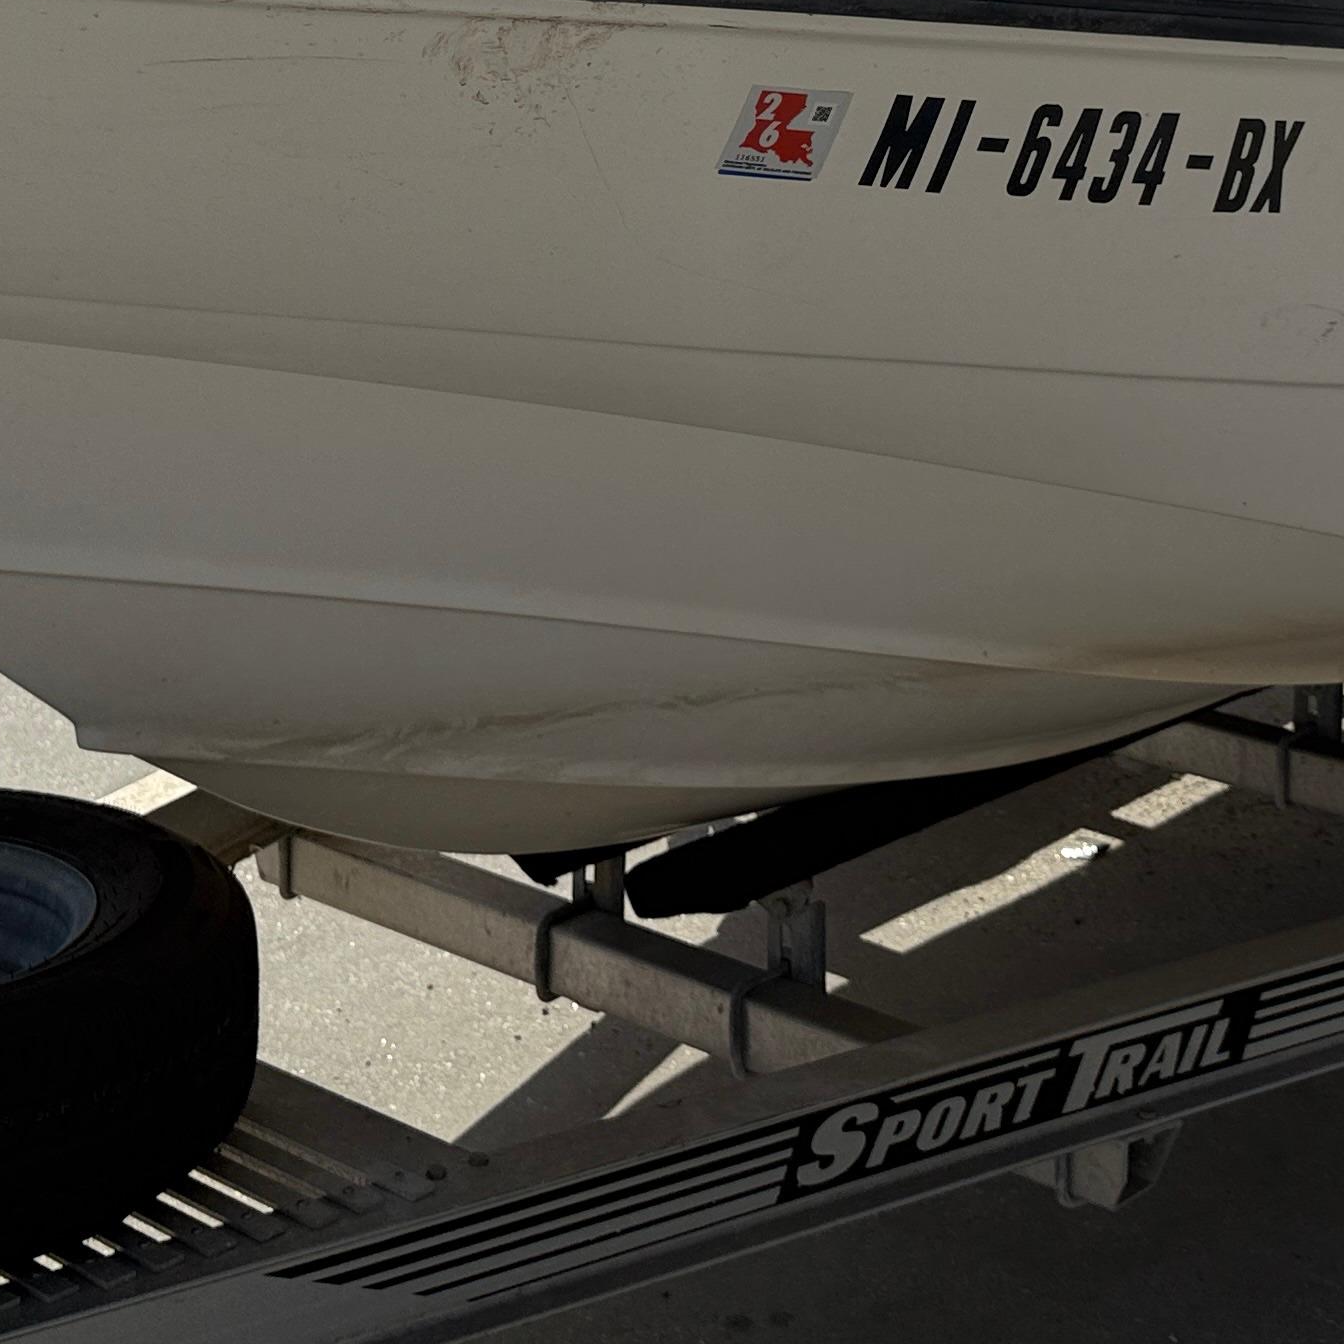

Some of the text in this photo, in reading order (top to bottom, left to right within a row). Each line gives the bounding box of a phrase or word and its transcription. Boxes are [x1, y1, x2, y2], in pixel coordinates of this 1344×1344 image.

[756, 92, 783, 121] 2
[759, 121, 783, 149] 6
[858, 94, 1305, 214] MI-6434-BX
[797, 999, 1230, 1187] SPORT TRAIL
